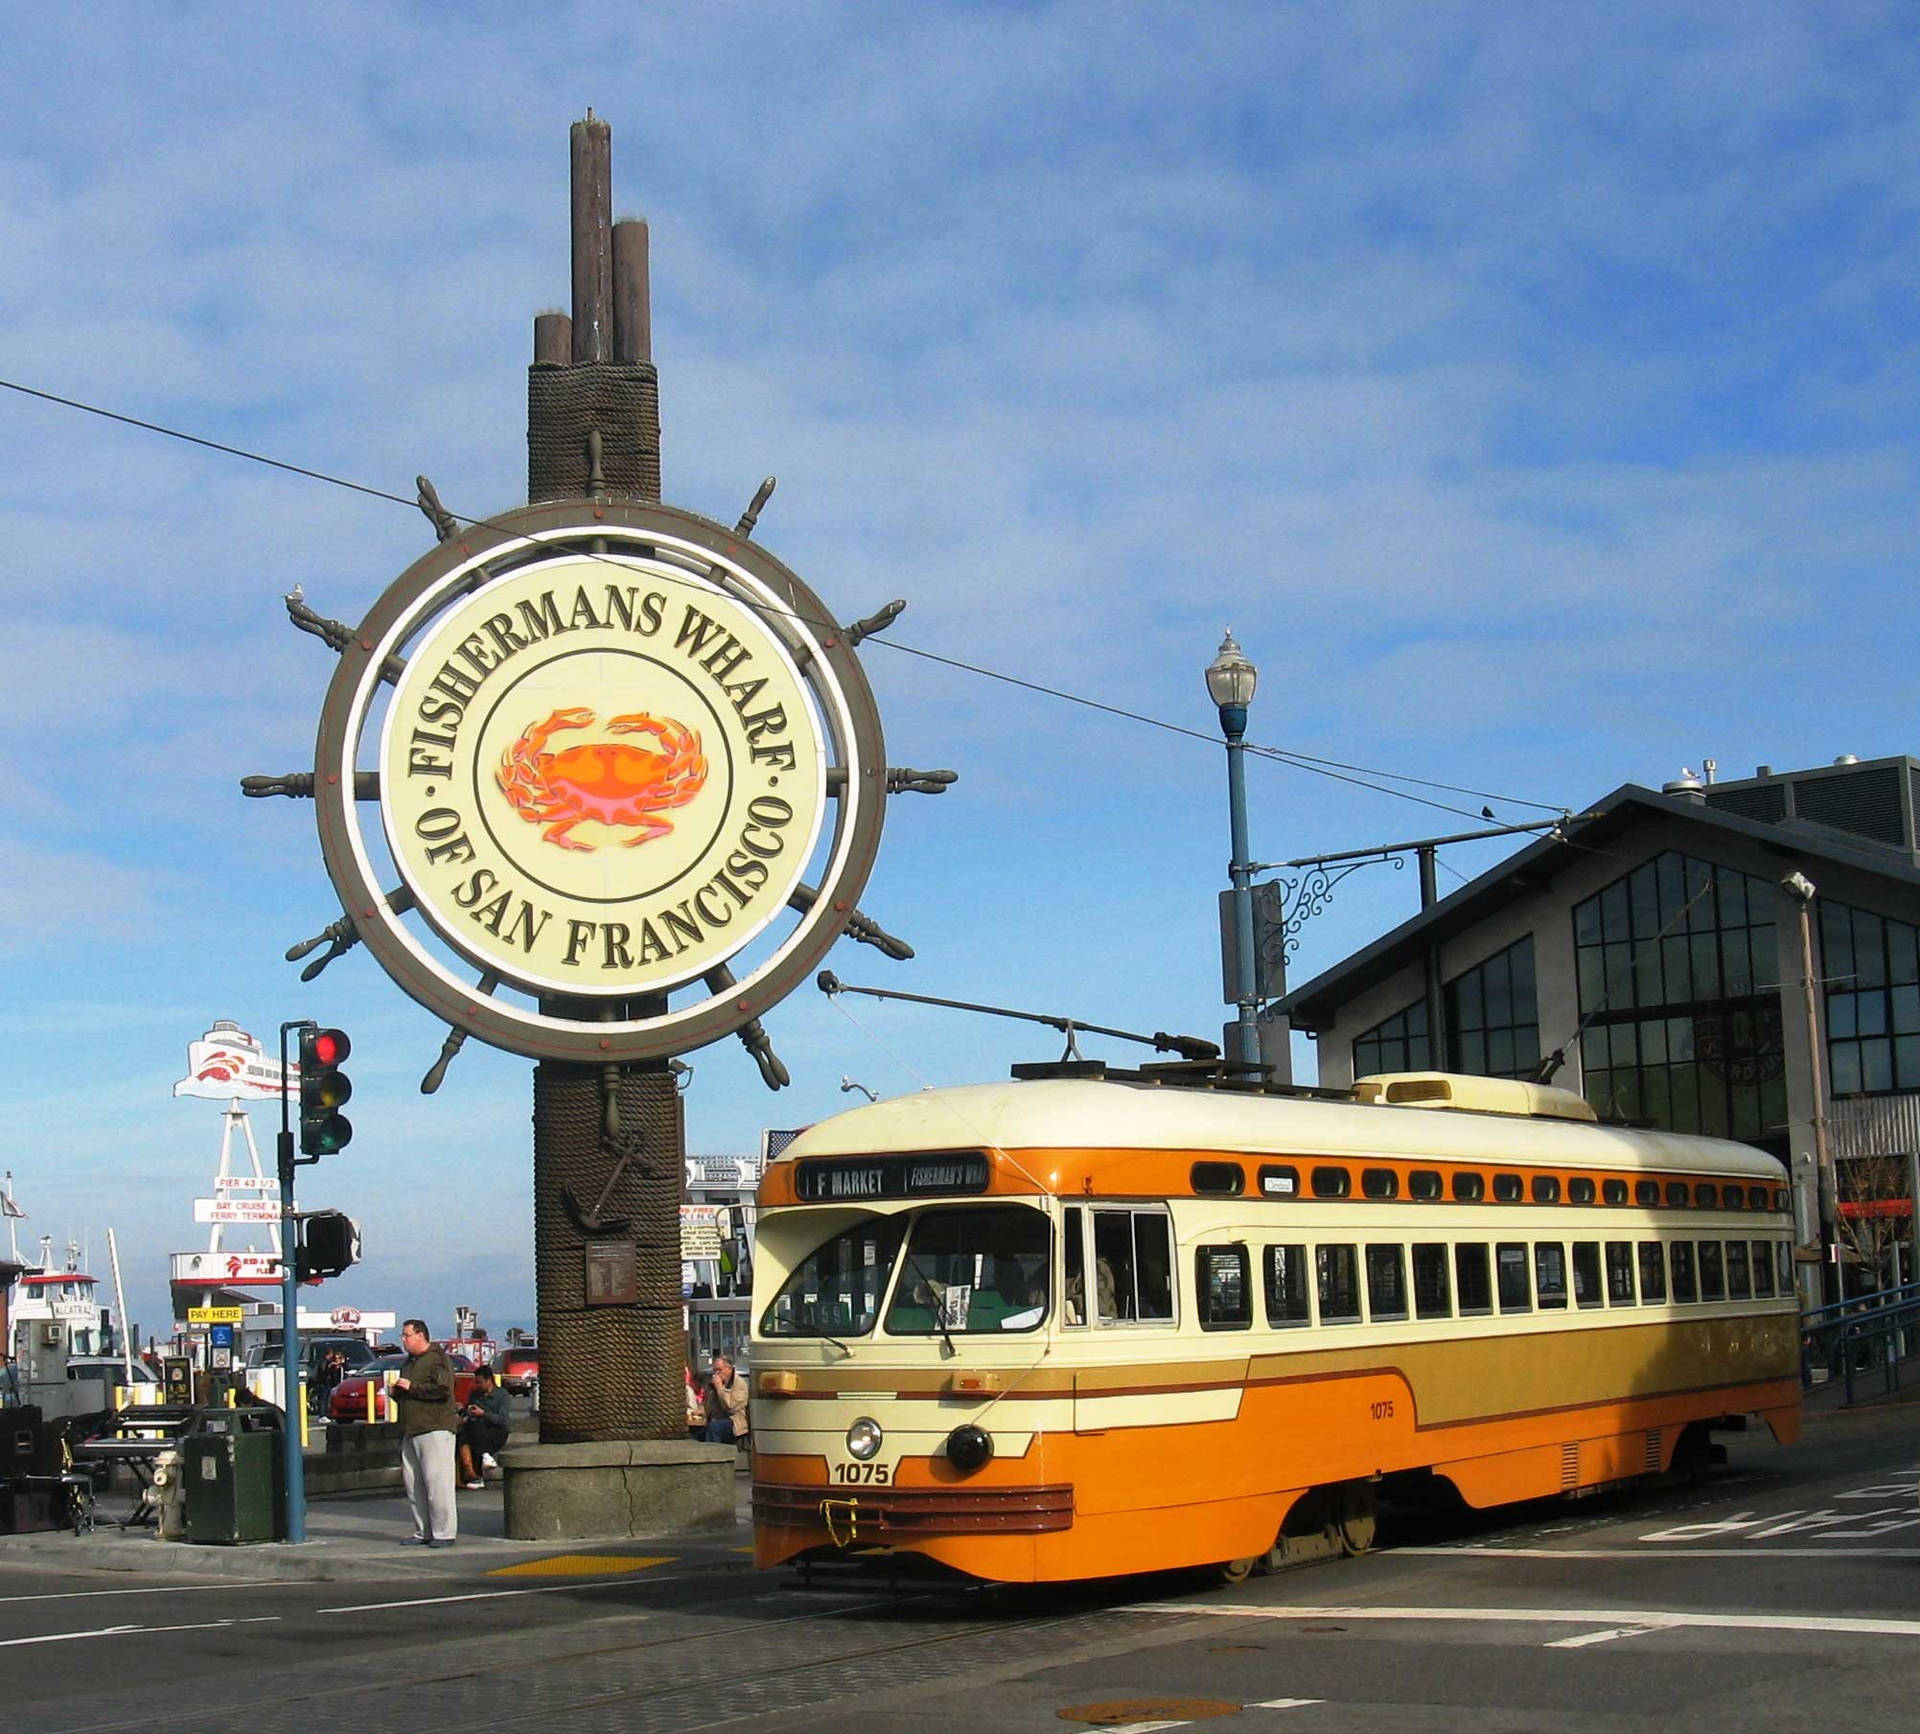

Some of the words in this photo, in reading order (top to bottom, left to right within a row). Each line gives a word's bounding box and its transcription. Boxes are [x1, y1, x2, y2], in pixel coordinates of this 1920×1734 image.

[408, 584, 667, 781] FISHERMANS
[672, 603, 797, 775] WHARF
[415, 807, 477, 865] OF
[451, 868, 553, 954] SAN
[561, 795, 794, 969] FRANCISCO
[220, 1179, 240, 1188] PIER
[244, 1179, 256, 1188] 43
[260, 1179, 275, 1188] 1/2
[817, 1172, 826, 1196] F
[832, 1169, 884, 1196] MARKET
[210, 1212, 237, 1220] FERRY
[242, 1212, 282, 1220] TERMINA
[216, 1202, 232, 1210] BAY
[236, 1202, 267, 1210] CRUISE
[190, 1309, 208, 1319] PAY
[212, 1309, 240, 1319] HERE
[1370, 1400, 1394, 1420] 1075
[834, 1463, 889, 1484] 1075
